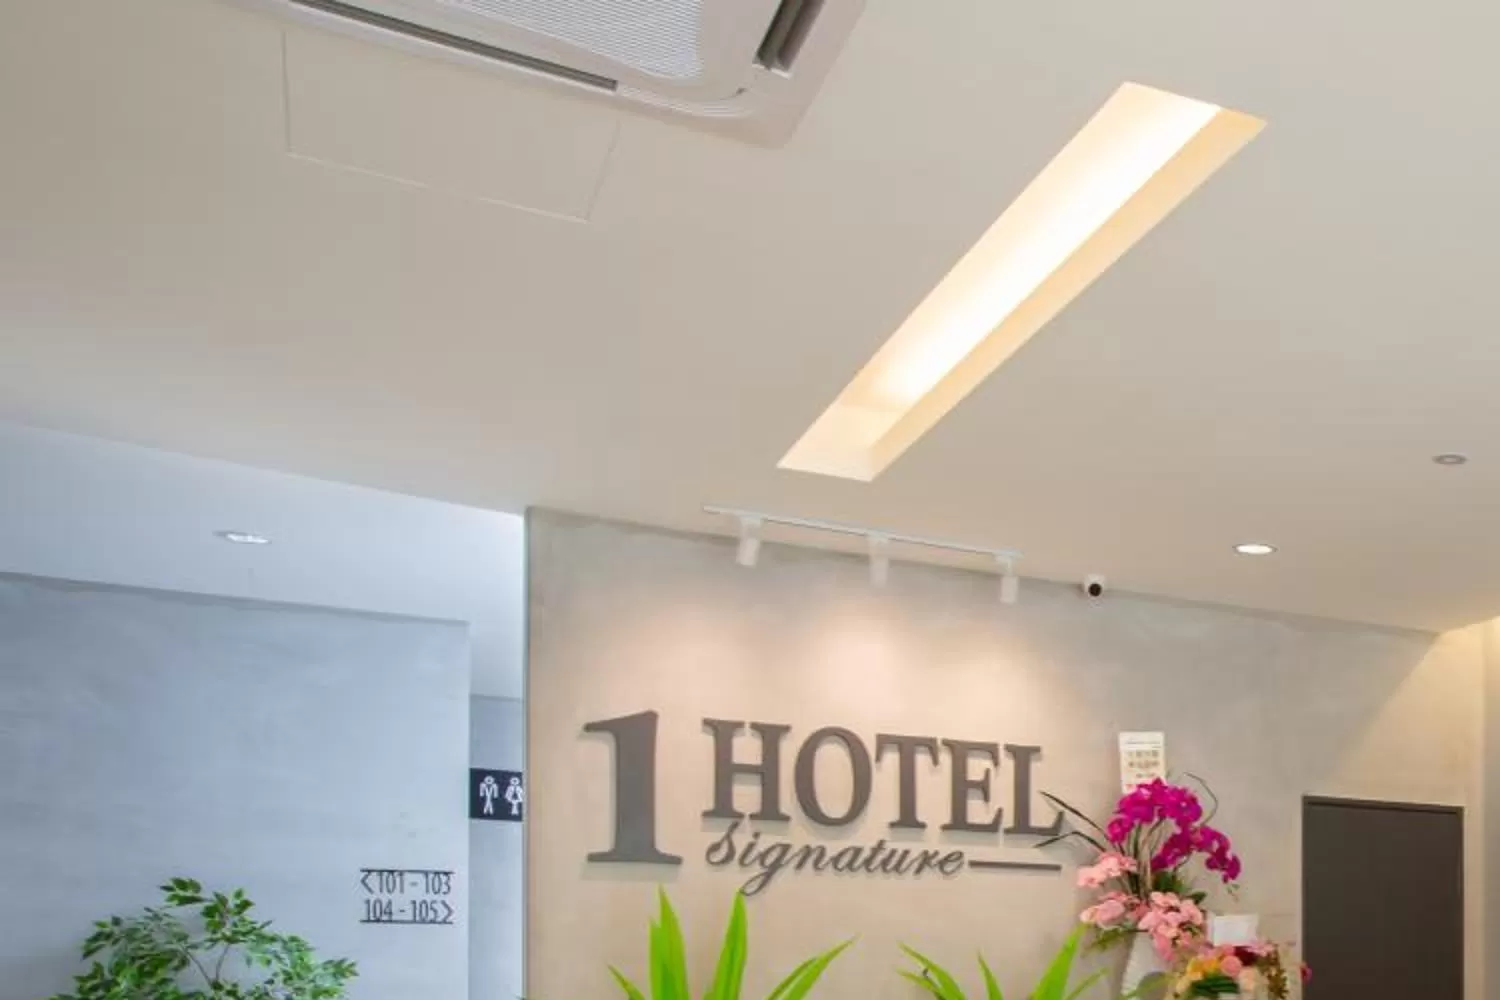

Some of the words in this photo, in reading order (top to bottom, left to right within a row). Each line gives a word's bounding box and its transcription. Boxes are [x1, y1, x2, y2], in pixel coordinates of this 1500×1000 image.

[584, 710, 683, 865] 1
[703, 718, 1063, 835] HOTEL
[377, 871, 405, 894] 101
[423, 872, 451, 895] 103
[705, 821, 966, 896] Signature
[364, 898, 393, 921] 104
[411, 900, 438, 922] 105
